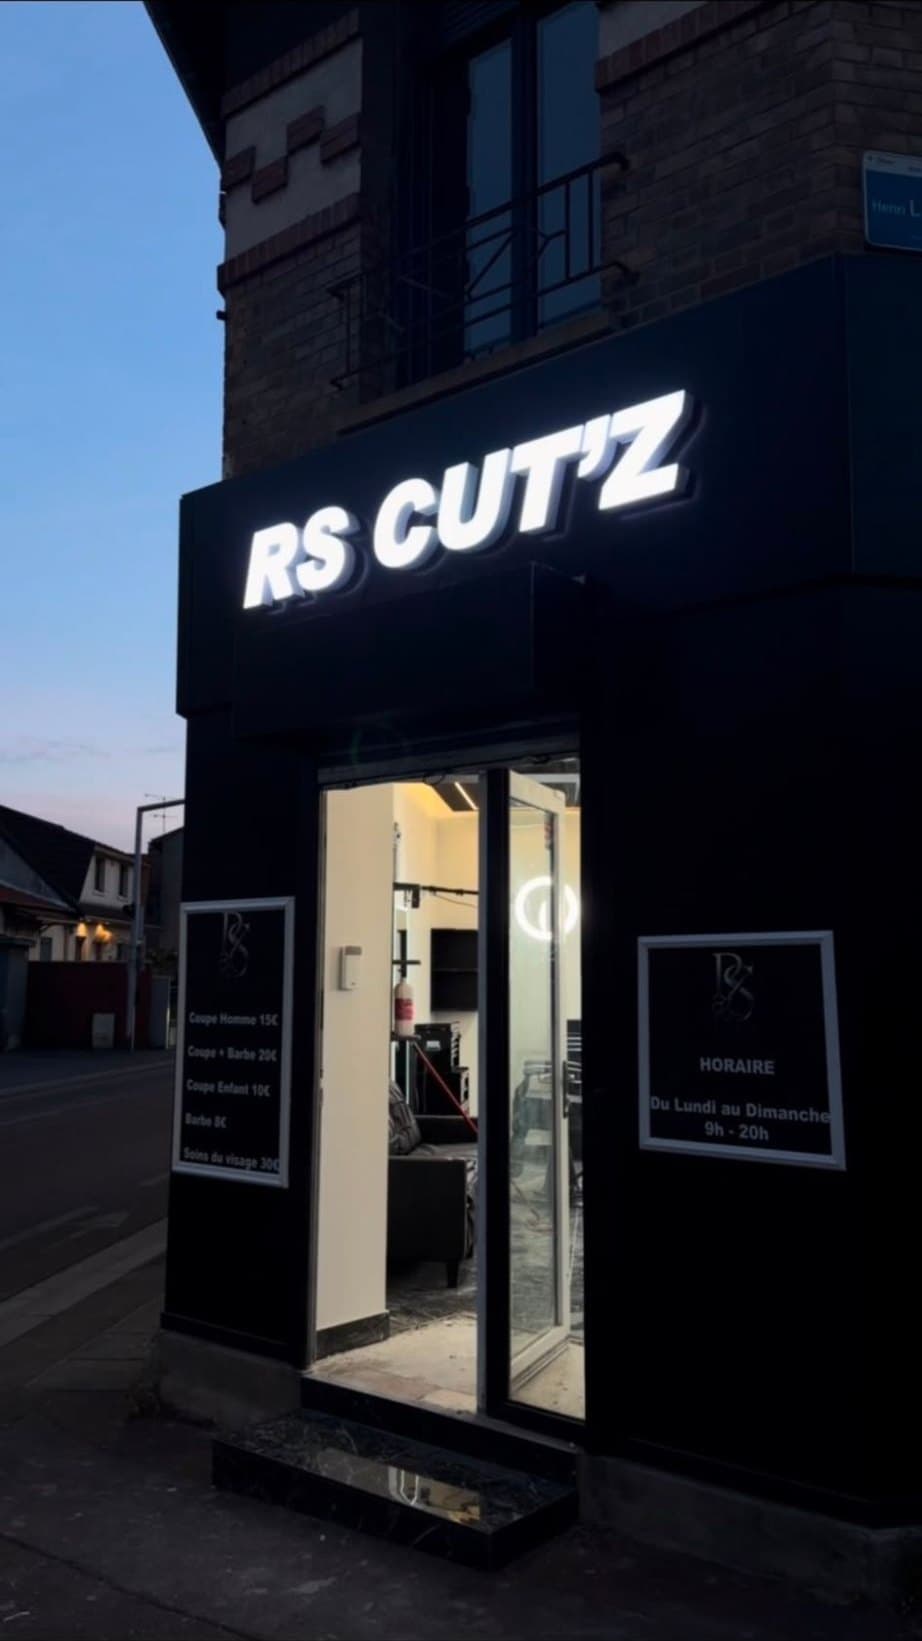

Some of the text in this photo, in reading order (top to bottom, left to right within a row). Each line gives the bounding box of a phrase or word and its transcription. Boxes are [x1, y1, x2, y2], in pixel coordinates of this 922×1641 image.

[243, 504, 359, 610] RS
[188, 1010, 280, 1027] Coupe Homme 15€
[187, 1044, 216, 1061] Coupe
[227, 1046, 256, 1061] Barbe
[258, 1048, 278, 1062] 20€
[699, 1056, 776, 1076] HORAIRE
[186, 1079, 272, 1098] Coupe Enfant 10€
[184, 1112, 212, 1127] Barbe
[650, 1095, 832, 1125] Du Lundi au Dimanche
[704, 1120, 725, 1137] 9h
[738, 1123, 770, 1142] 20h
[183, 1145, 209, 1162] Soins
[210, 1148, 223, 1163] du
[225, 1150, 259, 1171] visage
